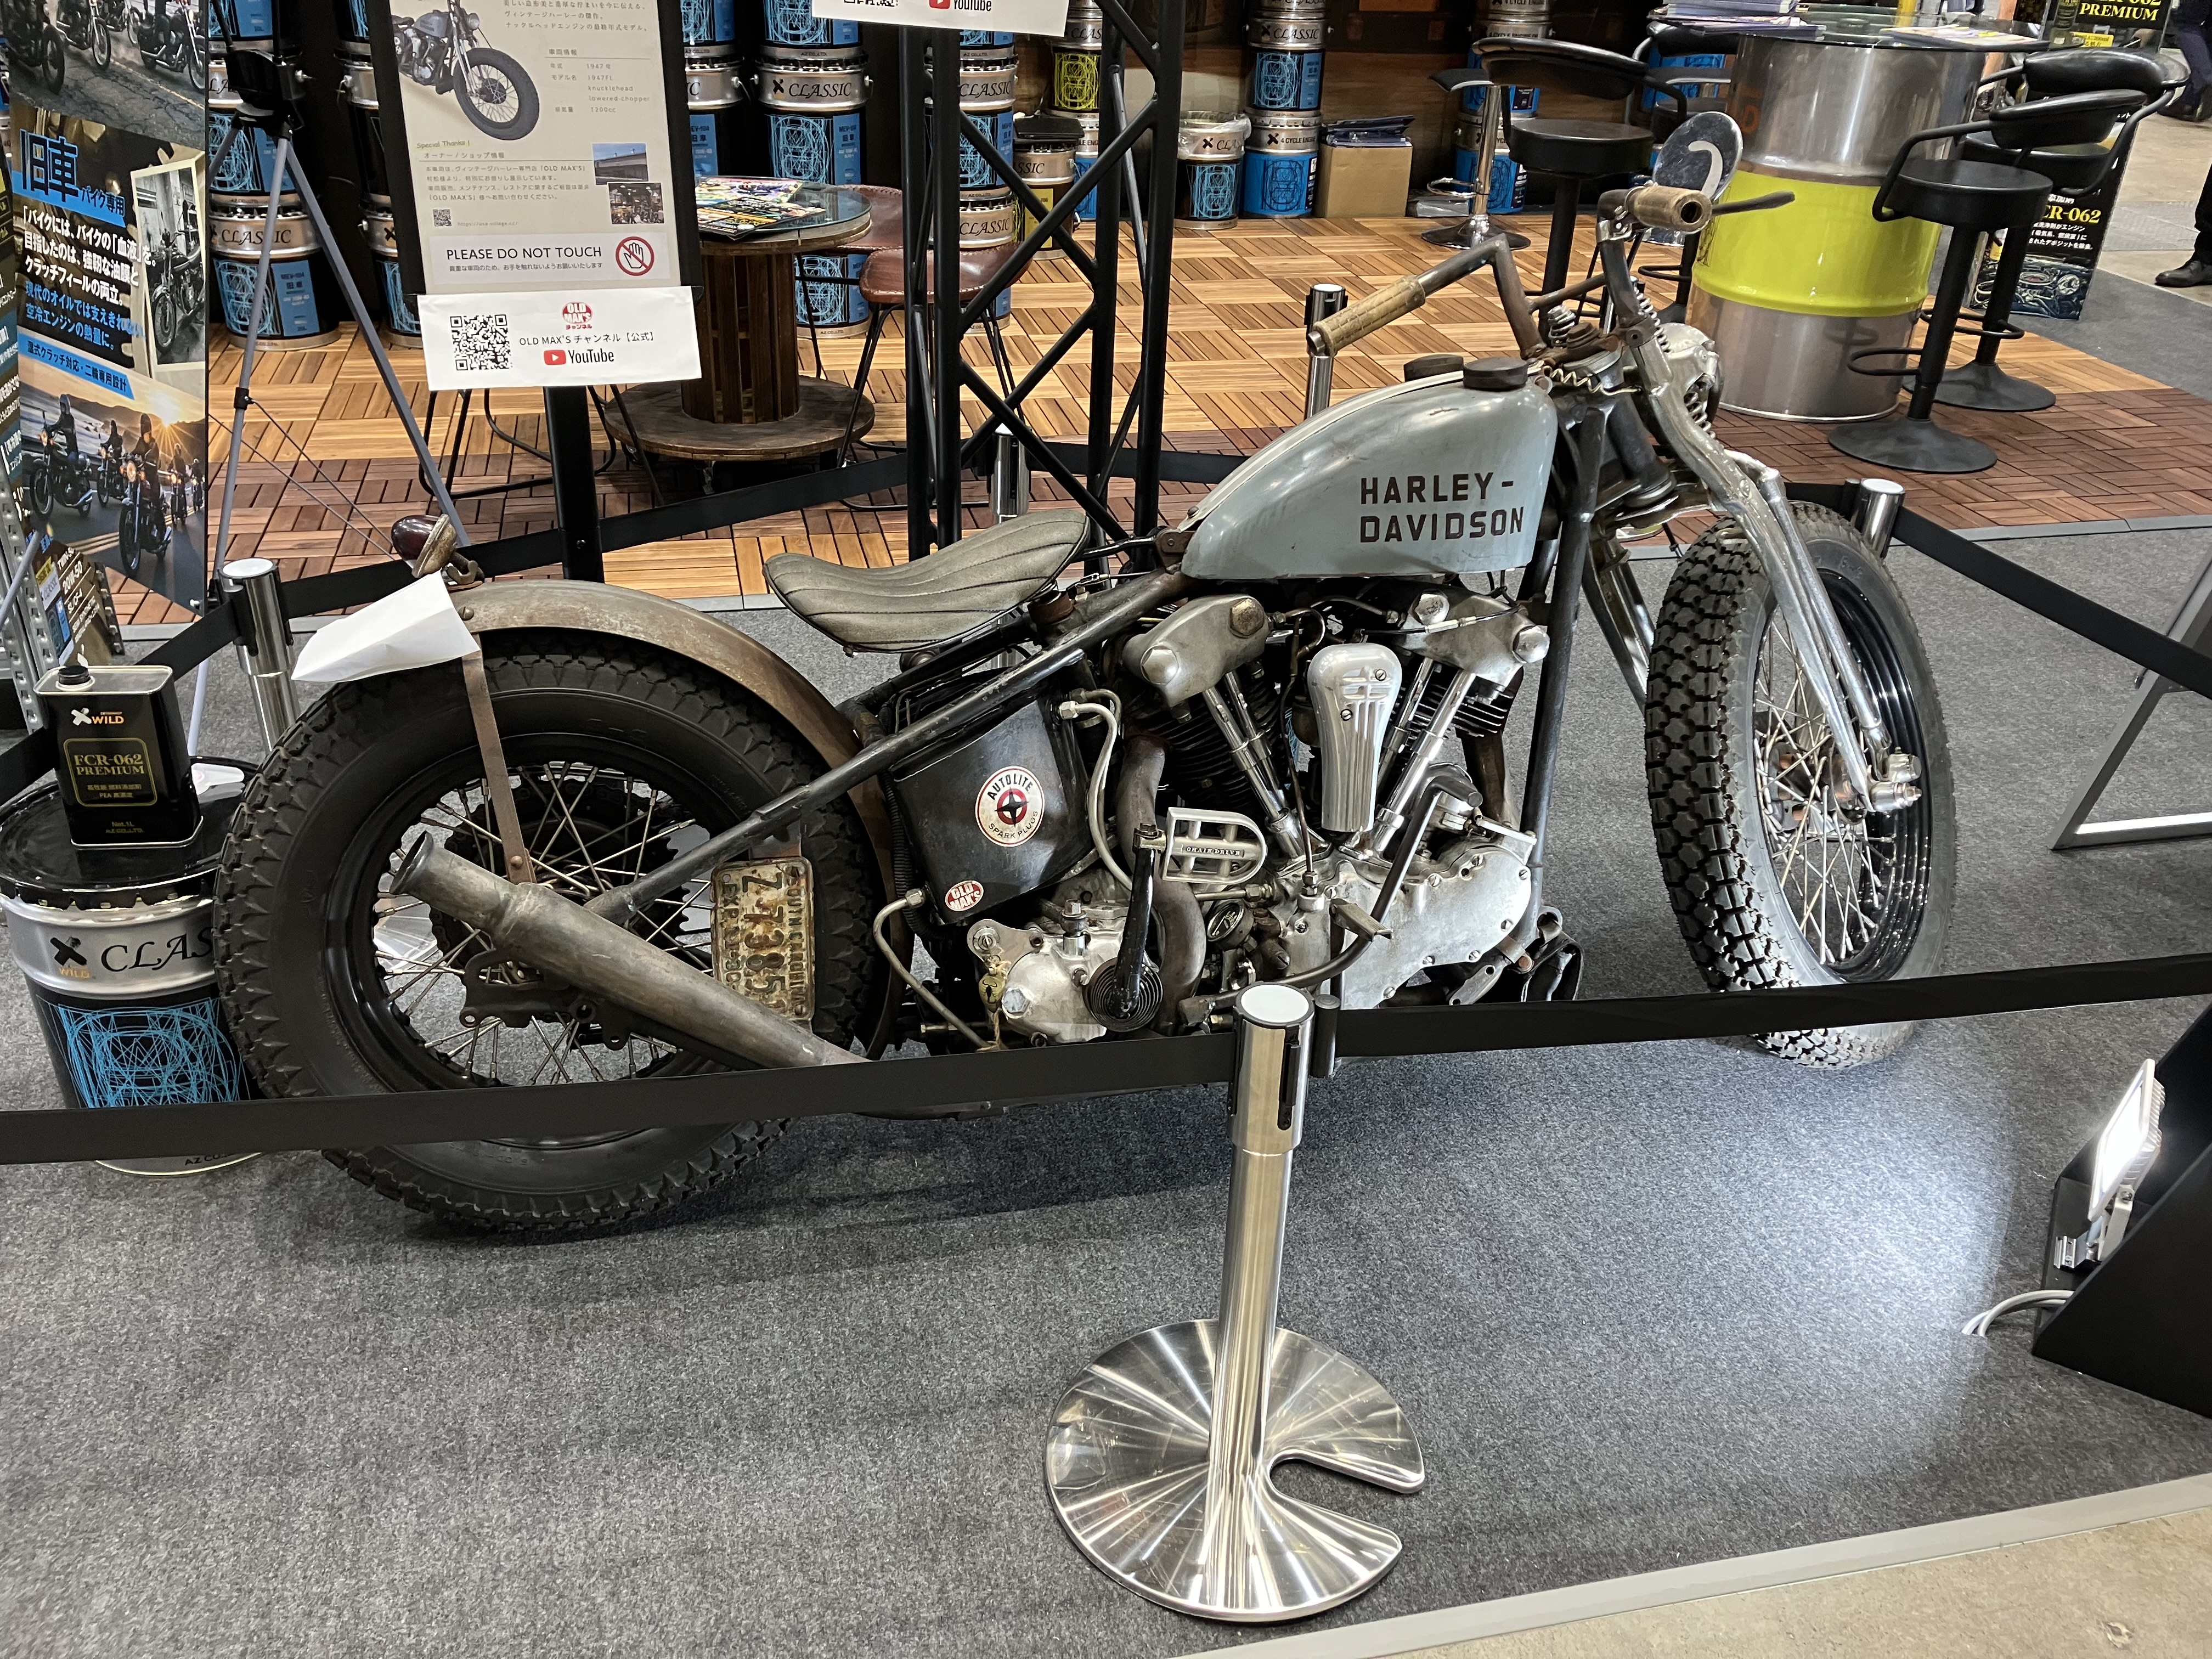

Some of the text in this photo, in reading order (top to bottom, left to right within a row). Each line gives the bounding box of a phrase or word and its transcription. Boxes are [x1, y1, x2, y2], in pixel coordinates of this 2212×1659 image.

[2079, 3, 2159, 21] PREMIUM
[1071, 28, 1102, 40] CLAS
[1273, 29, 1319, 40] CLASSIC
[788, 82, 852, 99] CLASSIC
[960, 81, 1012, 98] CLASSIC
[20, 128, 126, 217] 旧車 バイク専用
[2043, 205, 2101, 223] R-062
[960, 218, 1011, 236] CLASSIC
[222, 229, 292, 245] CLASIC
[447, 246, 602, 260] PLEASE DO NOT TOUCH
[25, 255, 123, 306] クラッチフィールの両立。
[567, 303, 587, 313] OLD
[520, 337, 539, 346] OLD
[542, 335, 571, 345] MAX'S
[568, 349, 614, 364] YouTube
[1361, 472, 1514, 505] HARLEY-
[1360, 506, 1524, 543] DAVIDSON
[91, 715, 125, 725] WILD
[74, 753, 143, 766] FCR-062
[76, 765, 145, 776] PREMIUM
[987, 774, 1034, 800] AUTOLITE
[989, 811, 1038, 838] SPARK PLUGS
[950, 890, 981, 910] MAX'S
[951, 883, 974, 900] OLD
[100, 926, 213, 973] CLAS
[59, 967, 91, 979] WILD
